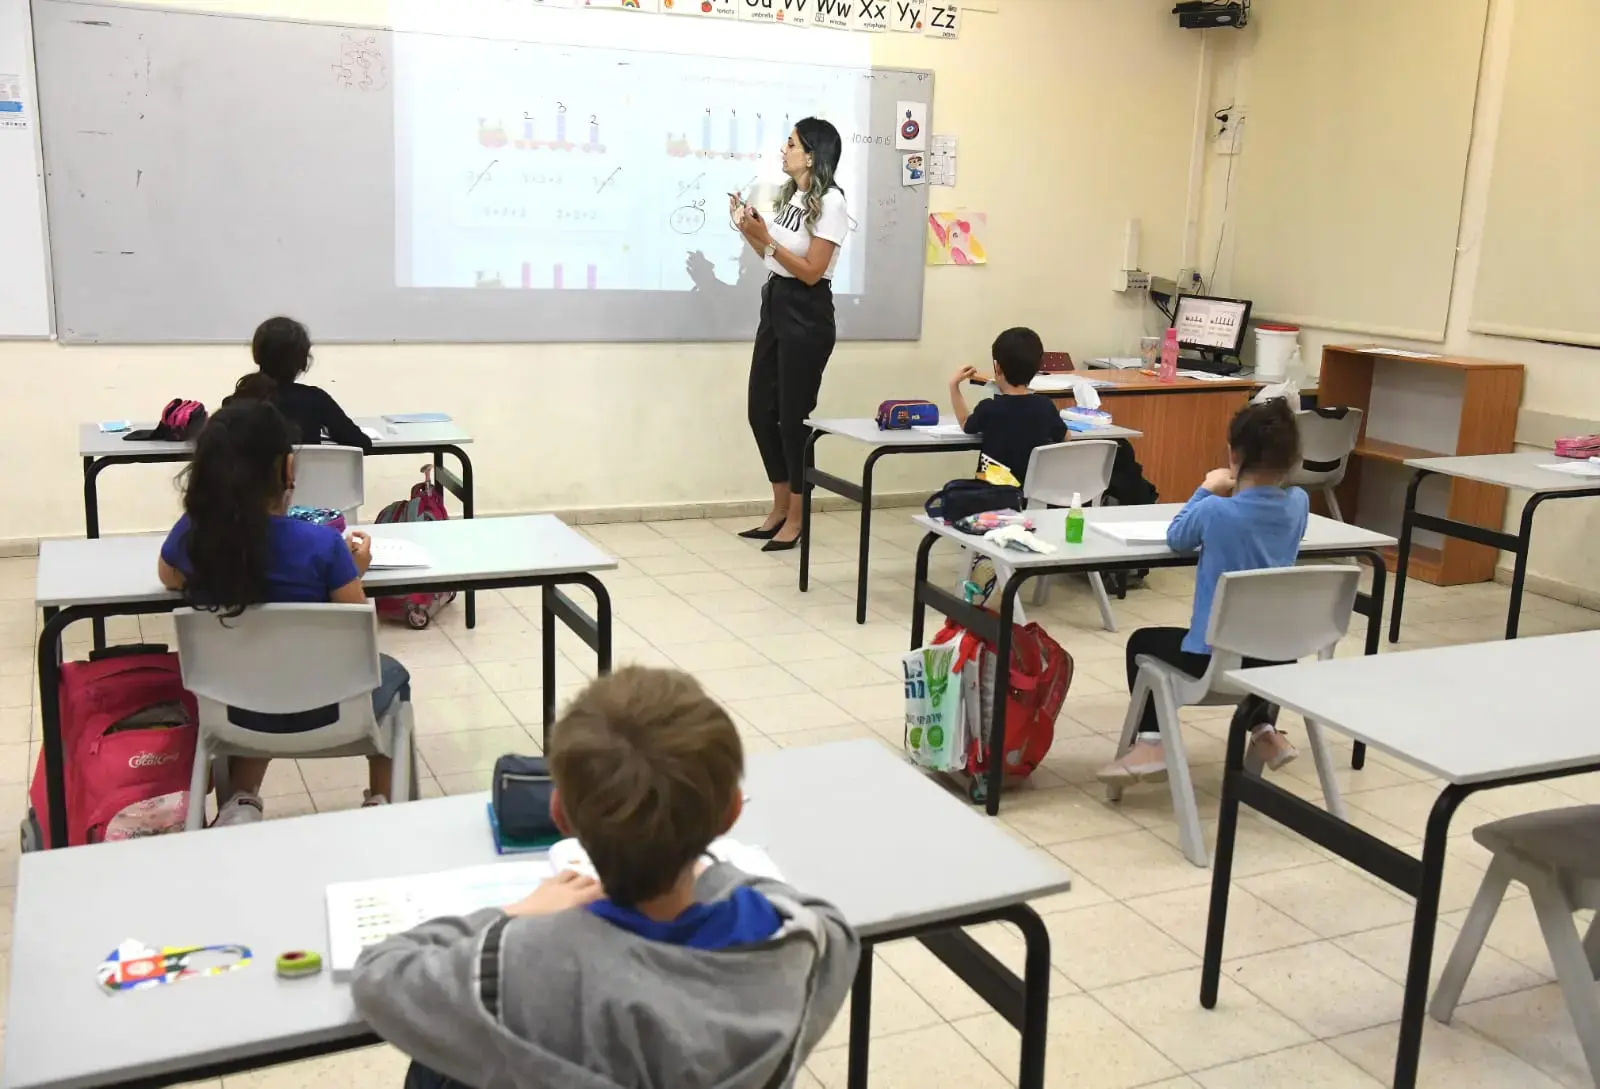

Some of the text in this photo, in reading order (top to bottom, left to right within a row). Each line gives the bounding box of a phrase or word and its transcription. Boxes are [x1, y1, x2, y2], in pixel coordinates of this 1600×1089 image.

[859, 0, 886, 20] Xx
[897, 1, 920, 29] Yy
[931, 6, 956, 29] Zz
[523, 101, 599, 126] 2 3 2
[705, 107, 711, 117] 4
